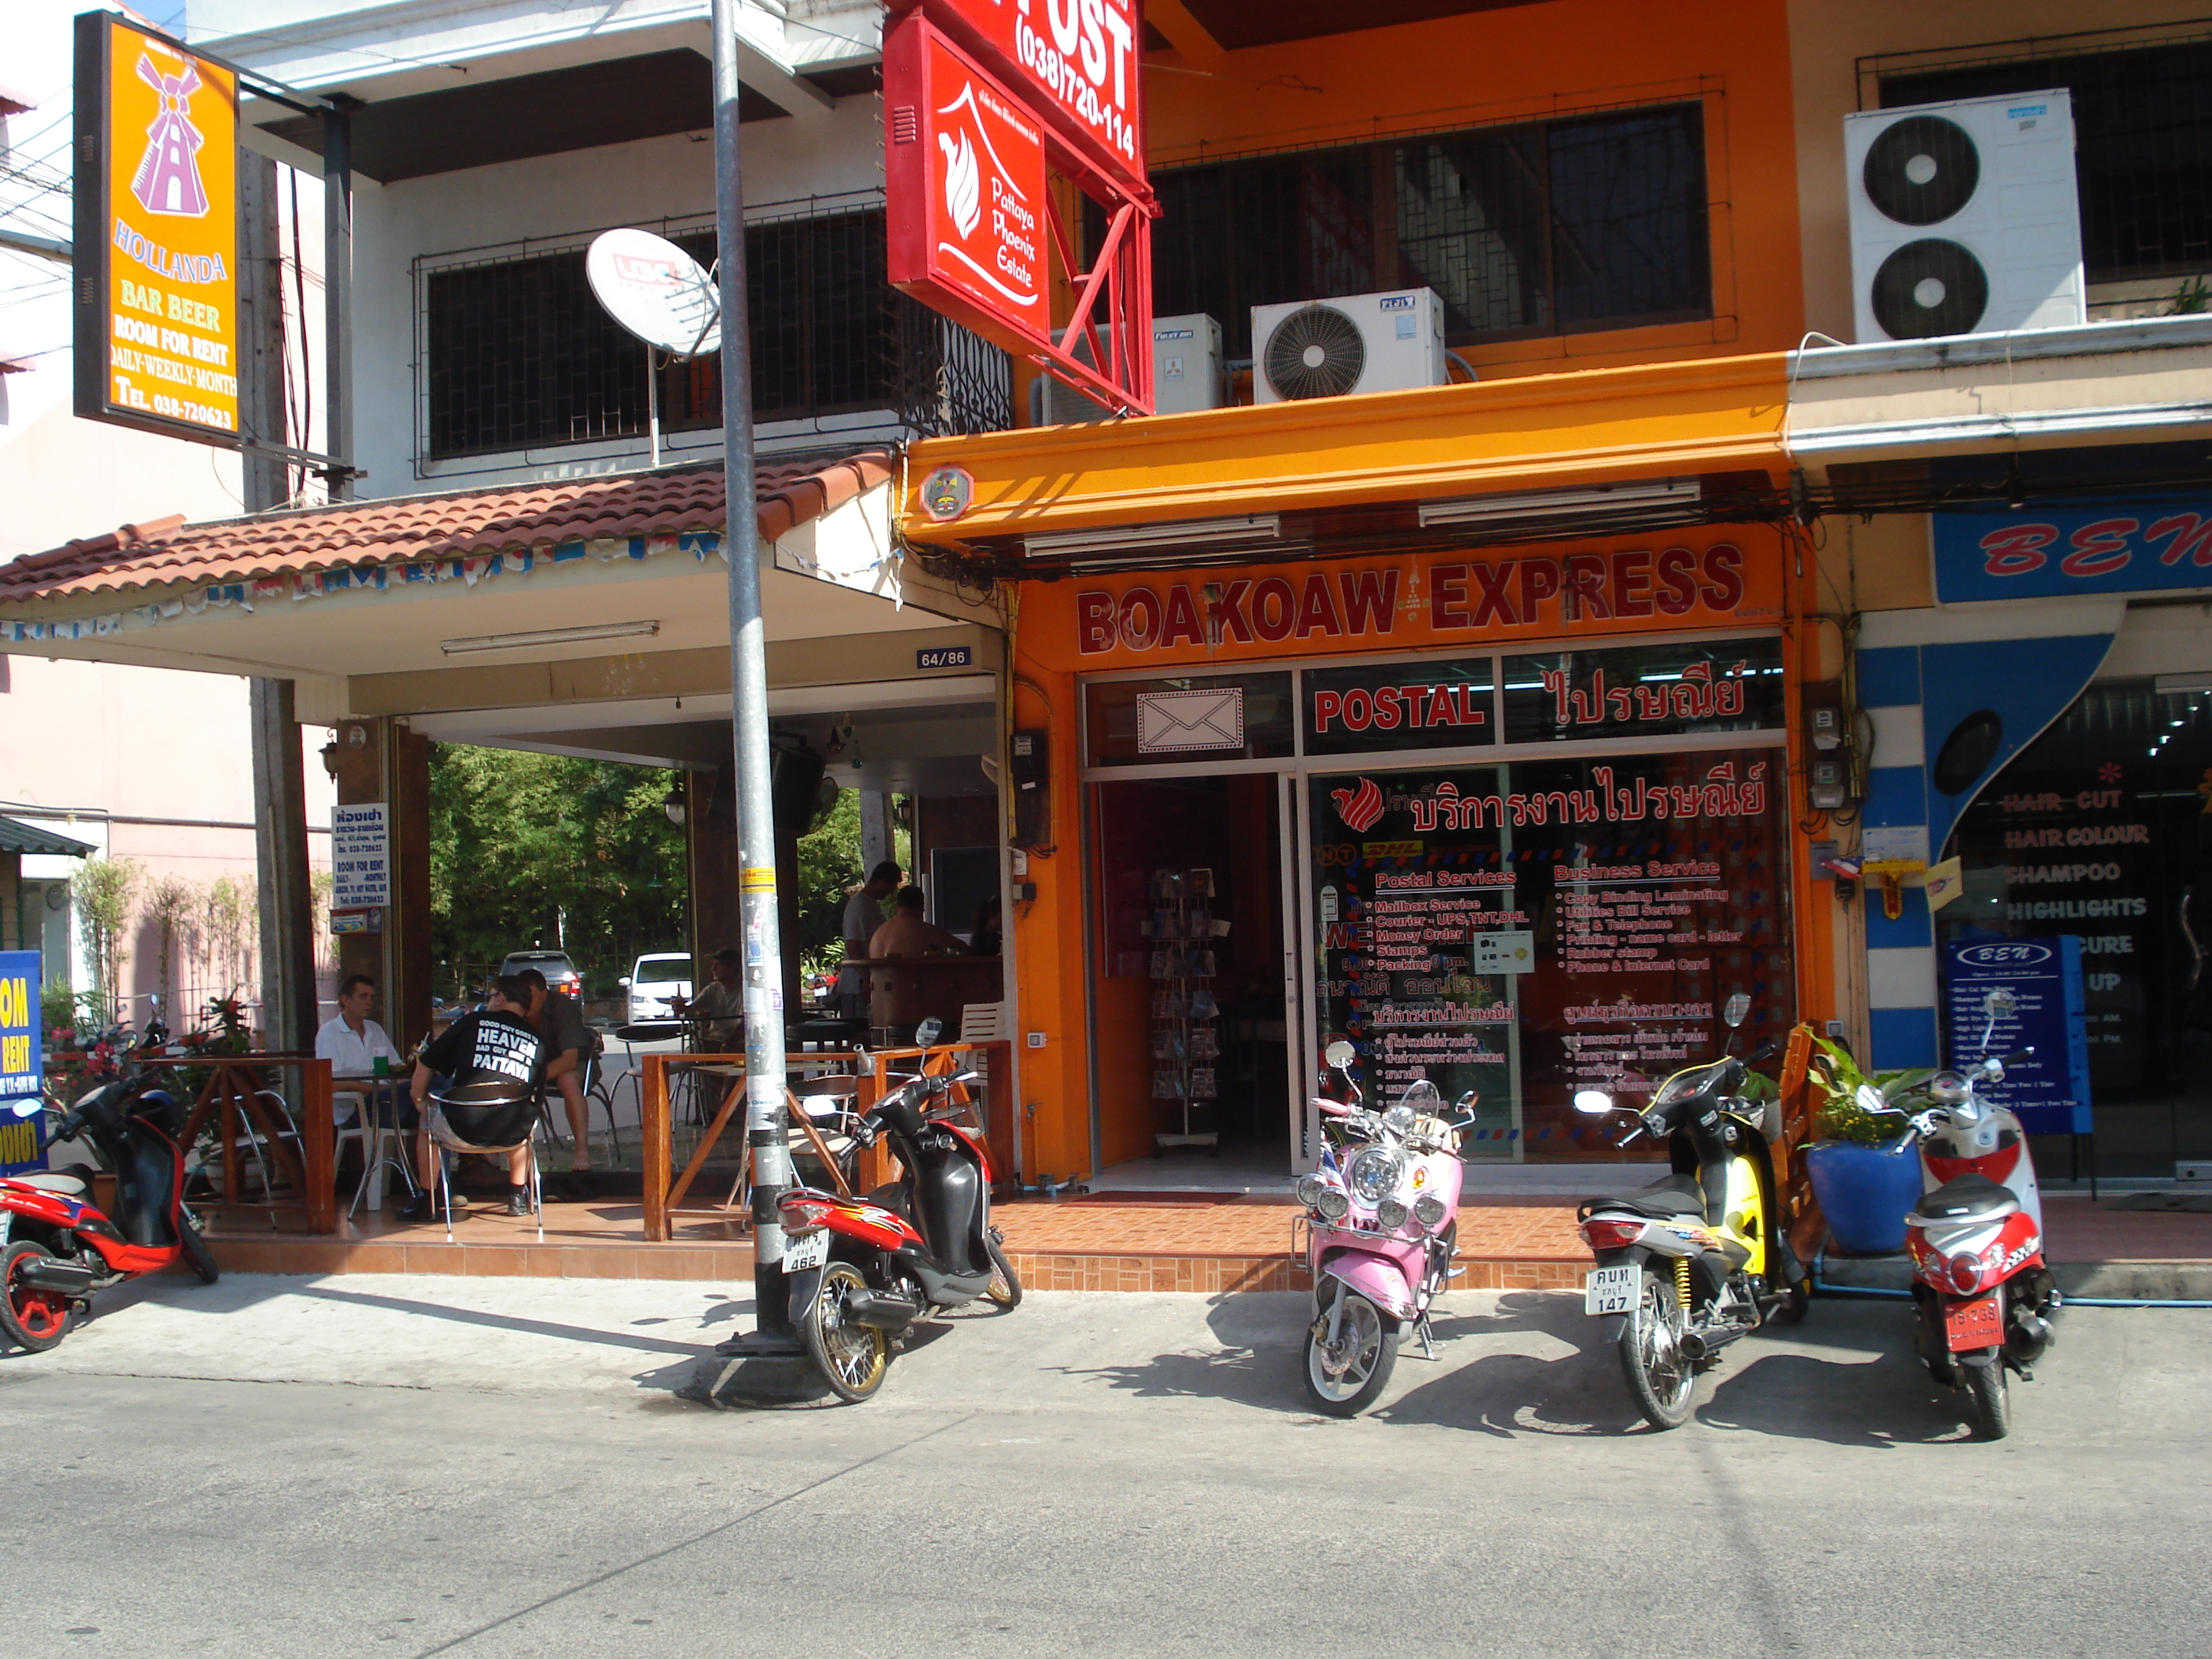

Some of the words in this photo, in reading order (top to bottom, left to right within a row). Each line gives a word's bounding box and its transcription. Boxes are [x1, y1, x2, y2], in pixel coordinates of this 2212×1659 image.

[1017, 0, 1132, 111] OST
[1015, 13, 1135, 160] (038)720-114
[991, 176, 1035, 230] Pattaya
[992, 210, 1036, 262] Phoenix
[114, 217, 228, 284] HOLLANDA
[997, 245, 1033, 289] Estate
[121, 279, 163, 318] BAR
[166, 292, 221, 332] BEER
[114, 313, 158, 349] ROOM
[161, 325, 190, 356] FOR
[192, 335, 229, 367] RENT
[153, 393, 232, 429] 038-720623
[1429, 544, 1744, 631] EXPRESS
[922, 652, 966, 667] 64/86
[1540, 659, 1747, 725] ไปรษณีย์
[1314, 683, 1485, 732] POSTAL
[1411, 761, 1766, 832] บริการงานไปรษณีย์
[2003, 792, 2064, 812] HAIR
[2077, 790, 2123, 809] CUT
[2005, 828, 2065, 849] HAIR
[2066, 824, 2151, 847] COLOUR
[337, 860, 354, 873] ROOM
[356, 860, 368, 871] FOR
[369, 860, 384, 871] RENT
[1554, 863, 1643, 881] Business
[1647, 859, 1721, 877] Service
[2005, 862, 2121, 885] SHAMPOO
[1375, 871, 1433, 889] Postal
[1437, 868, 1516, 886] Services
[1375, 900, 1429, 914] Mailbox
[1429, 898, 1482, 911] Service
[1563, 892, 1600, 907] Copy
[1601, 890, 1653, 904] Binding
[1655, 888, 1730, 902] Laminating
[1565, 905, 1615, 919] Utilities
[1617, 904, 1640, 917] Bill
[1641, 903, 1692, 916] Service
[2008, 897, 2147, 921] HIGHLIGHTS
[1375, 914, 1427, 928] Courier
[1565, 920, 1591, 932] Fax
[1592, 920, 1604, 931] &
[1605, 918, 1673, 932] Telephone
[1376, 930, 1421, 943] Money
[1423, 928, 1463, 940] Order
[1566, 933, 1619, 947] Printing
[1628, 935, 1665, 944] name
[1666, 931, 1698, 943] card
[1707, 930, 1743, 943] letter
[2078, 935, 2134, 955] CURE
[1376, 944, 1429, 958] Stamps
[1566, 947, 1616, 960] Rubber
[1617, 946, 1658, 960] stamp
[1977, 946, 2031, 962] BEN
[1377, 958, 1431, 973] Packing
[1567, 960, 1610, 974] Phone
[1624, 958, 1676, 971] Internet
[1677, 958, 1711, 971] Card
[479, 1019, 500, 1029] GOOD
[500, 1024, 515, 1033] GUY
[2, 1035, 30, 1074] RENT
[477, 1028, 537, 1060] HEAVEN
[492, 1046, 508, 1056] GUY
[472, 1053, 530, 1084] PATTAYA
[791, 1255, 817, 1271] 462
[1599, 1297, 1627, 1312] 147
